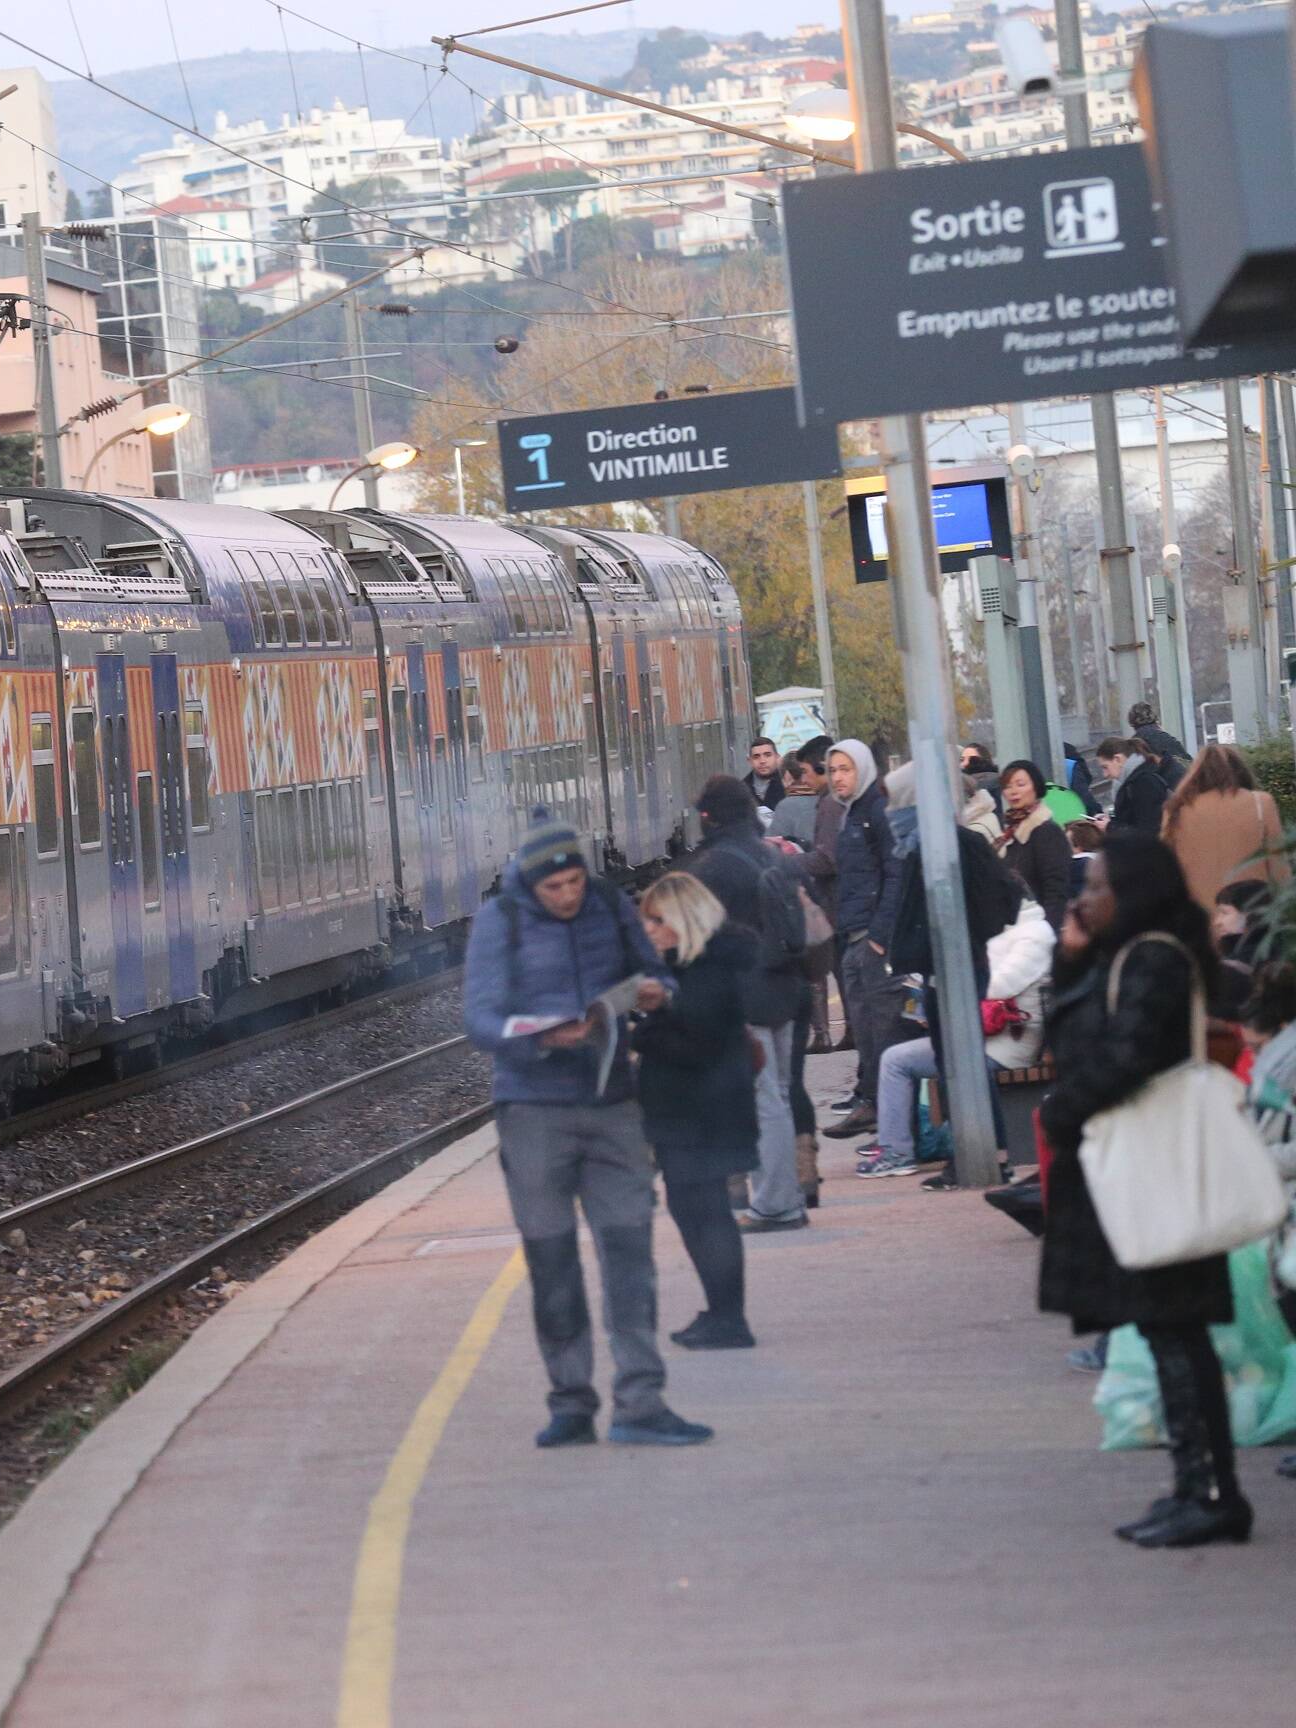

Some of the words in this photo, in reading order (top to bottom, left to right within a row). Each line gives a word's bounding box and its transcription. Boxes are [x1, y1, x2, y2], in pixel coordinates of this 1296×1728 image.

[910, 200, 1025, 243] Sortie
[909, 253, 947, 274] Exit
[898, 301, 1051, 338] Empruntez
[1056, 293, 1083, 319] le
[1101, 321, 1135, 341] the
[587, 423, 697, 453] Direction
[528, 448, 549, 481] 1
[588, 447, 729, 483] VINTIMILLE
